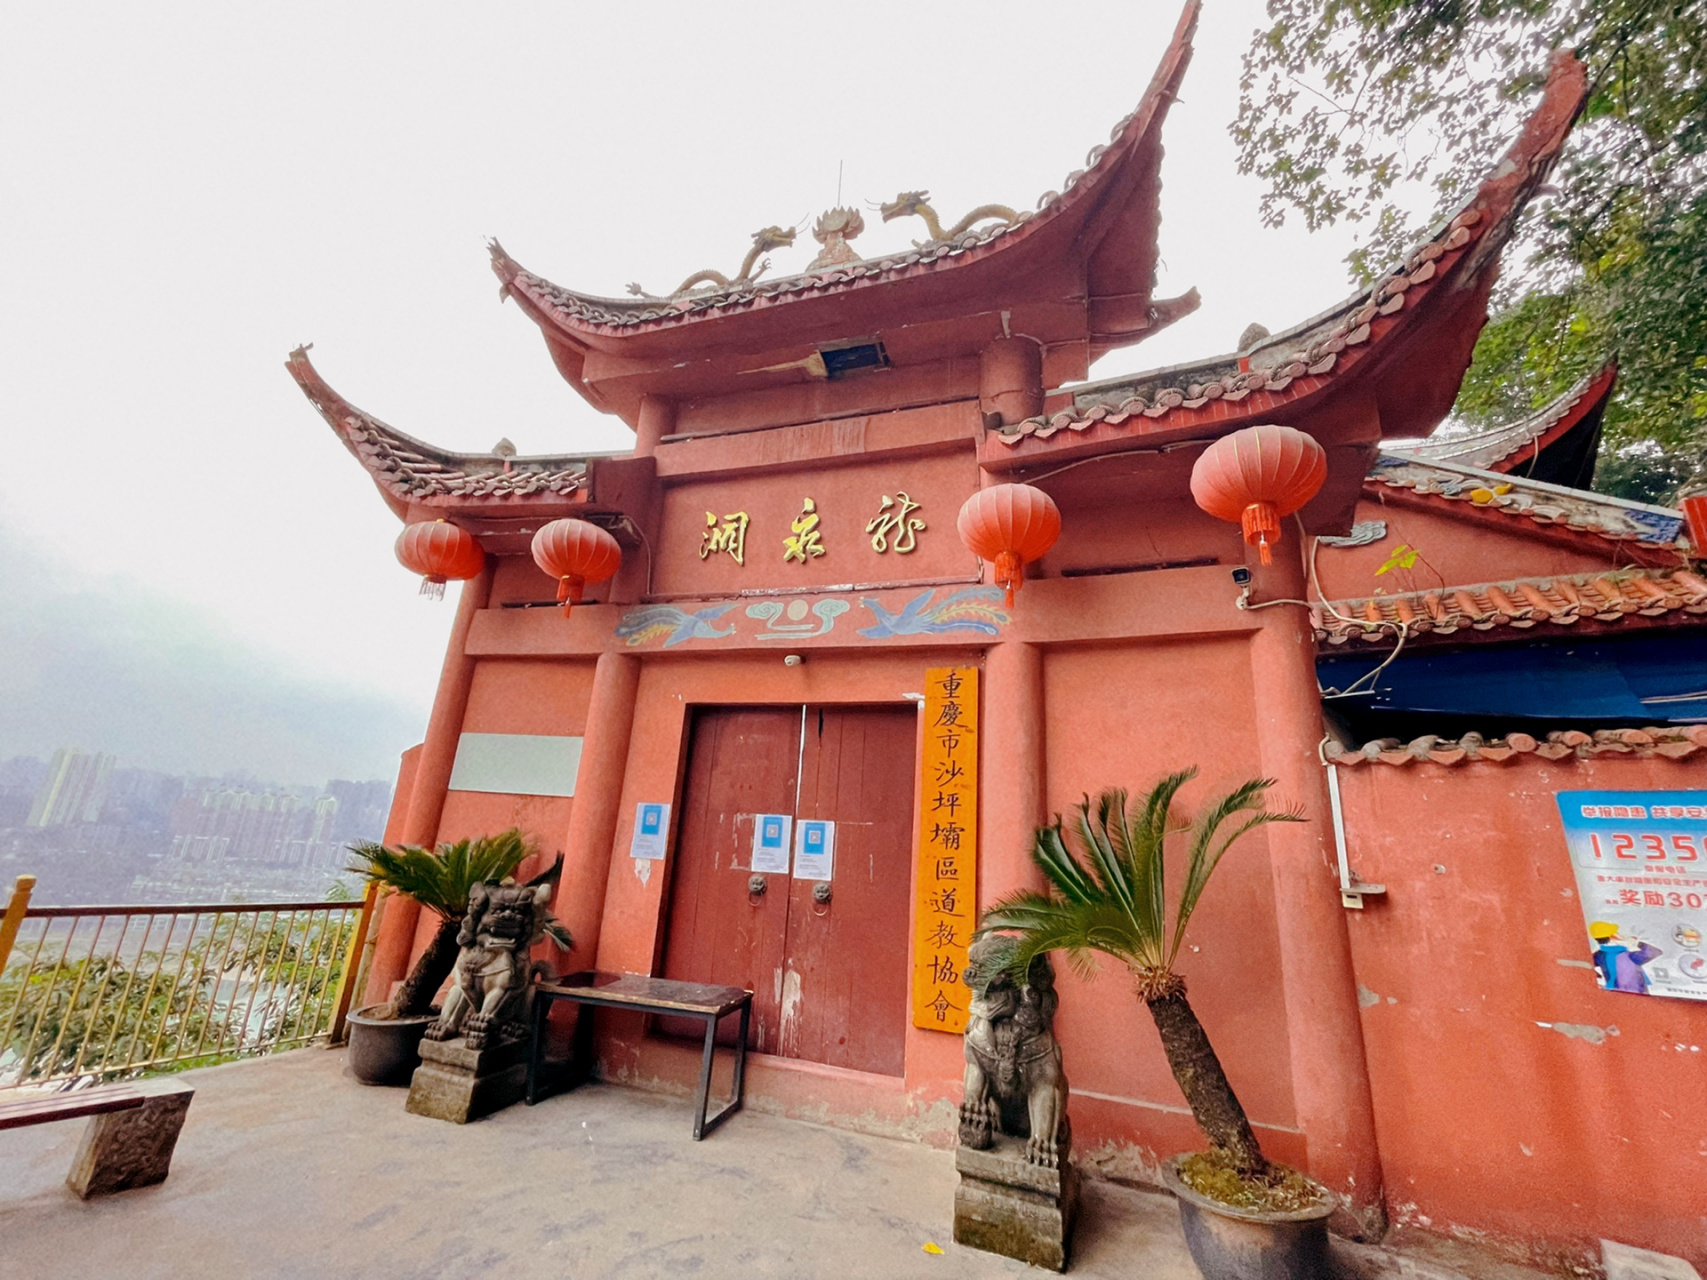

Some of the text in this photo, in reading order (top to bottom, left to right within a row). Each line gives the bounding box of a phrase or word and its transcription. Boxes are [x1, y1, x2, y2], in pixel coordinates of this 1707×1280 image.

[1650, 805, 1707, 820] 共享安
[1589, 832, 1707, 862] 1235
[1619, 889, 1707, 910] 奖励30
